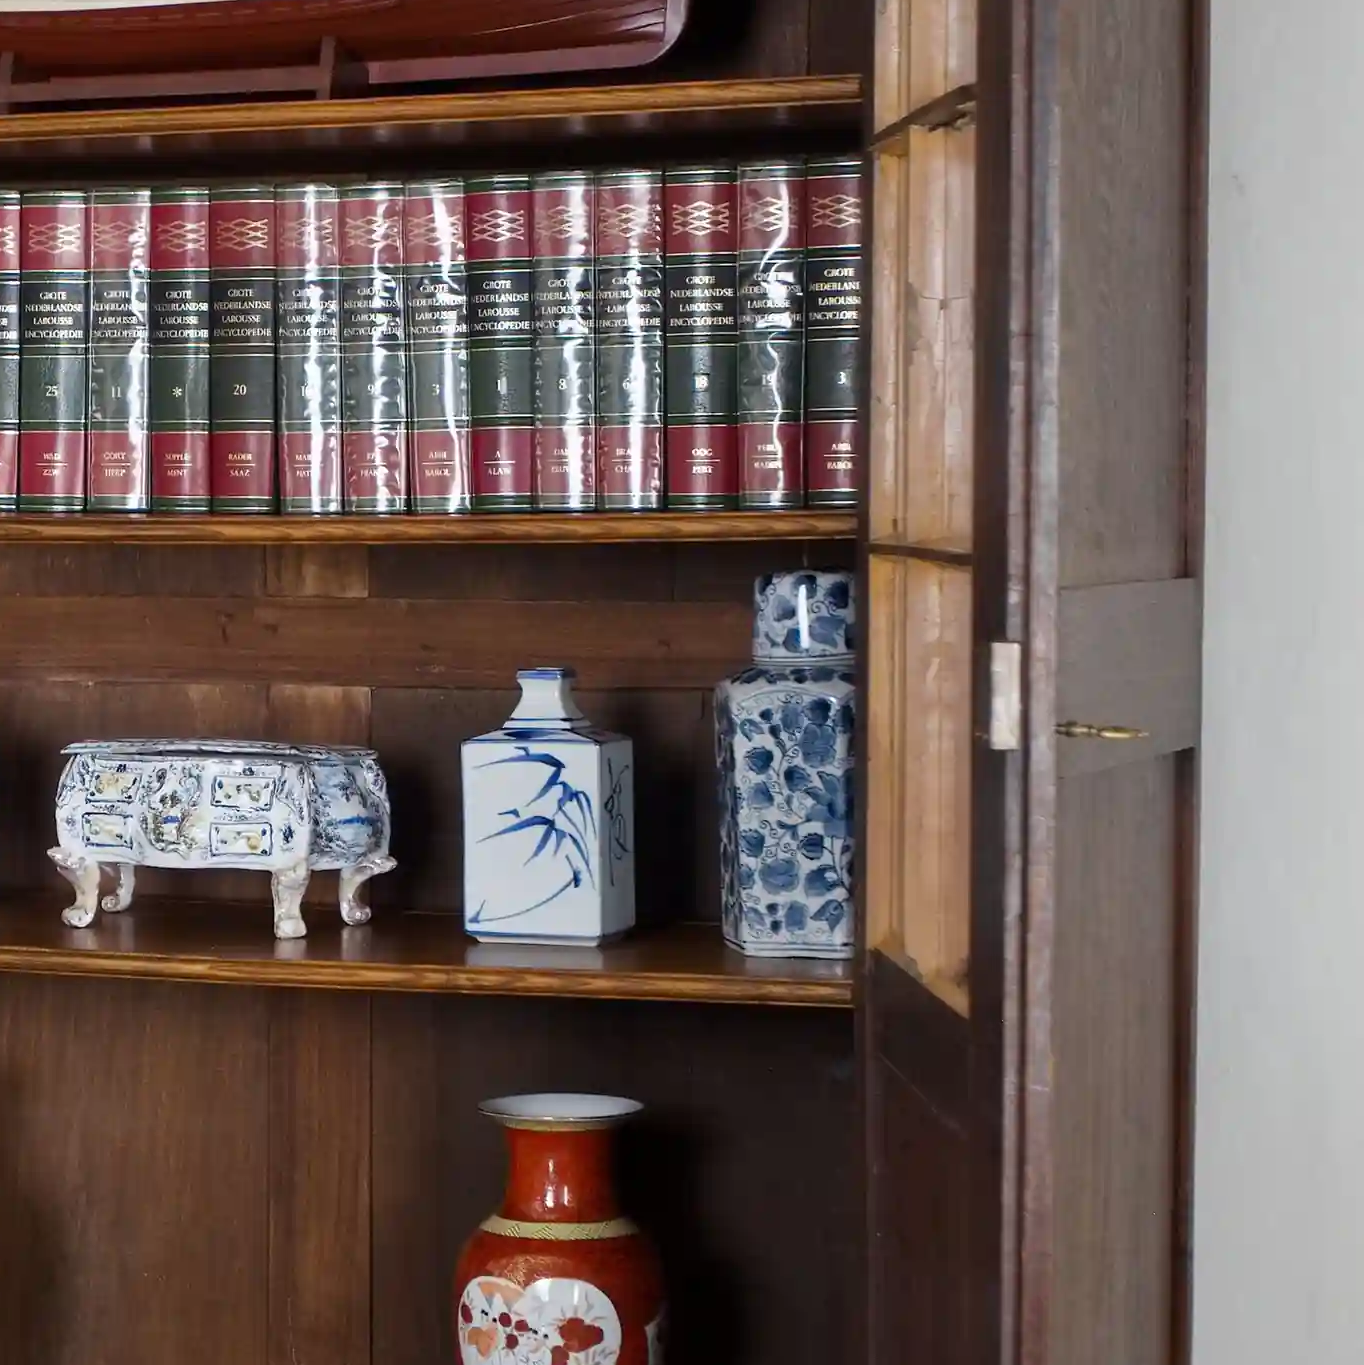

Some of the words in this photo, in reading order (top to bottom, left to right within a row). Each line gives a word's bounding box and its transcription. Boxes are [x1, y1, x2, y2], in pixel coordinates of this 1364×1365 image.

[823, 268, 855, 277] GROTE
[483, 280, 511, 289] GROTE
[686, 275, 716, 285] GROTE
[228, 288, 254, 297] GROTE
[419, 284, 449, 293] GROTE
[670, 288, 735, 298] NEDERLANDSE
[39, 291, 66, 300] GROTE
[165, 290, 192, 299] GROTE
[472, 292, 529, 303] NEDERLANDSE
[214, 300, 272, 310] NEDERLANDSE
[818, 296, 861, 306] LAROUSS
[25, 303, 83, 313] NEDERLANDSE
[478, 307, 520, 317] LAROUSSE
[679, 302, 724, 312] LAROUSSE
[33, 316, 73, 326] LAROUSSE
[98, 316, 138, 325] LAROUSSE
[160, 315, 200, 325] LAROUSSE
[222, 314, 261, 324] LAROUSSE
[670, 316, 735, 326] ENCYCLOPEDIE
[809, 311, 859, 321] ENCYCLOPE
[24, 330, 84, 339] ENCYCLOPEDIE
[213, 327, 272, 337] ENCYCLOPEDIE
[837, 371, 846, 384] 3
[367, 383, 375, 395] 9
[559, 378, 567, 390] 8
[45, 385, 58, 397] 25
[111, 386, 121, 398] 11
[233, 384, 247, 395] 20
[432, 383, 440, 396] 3
[495, 450, 501, 458] A
